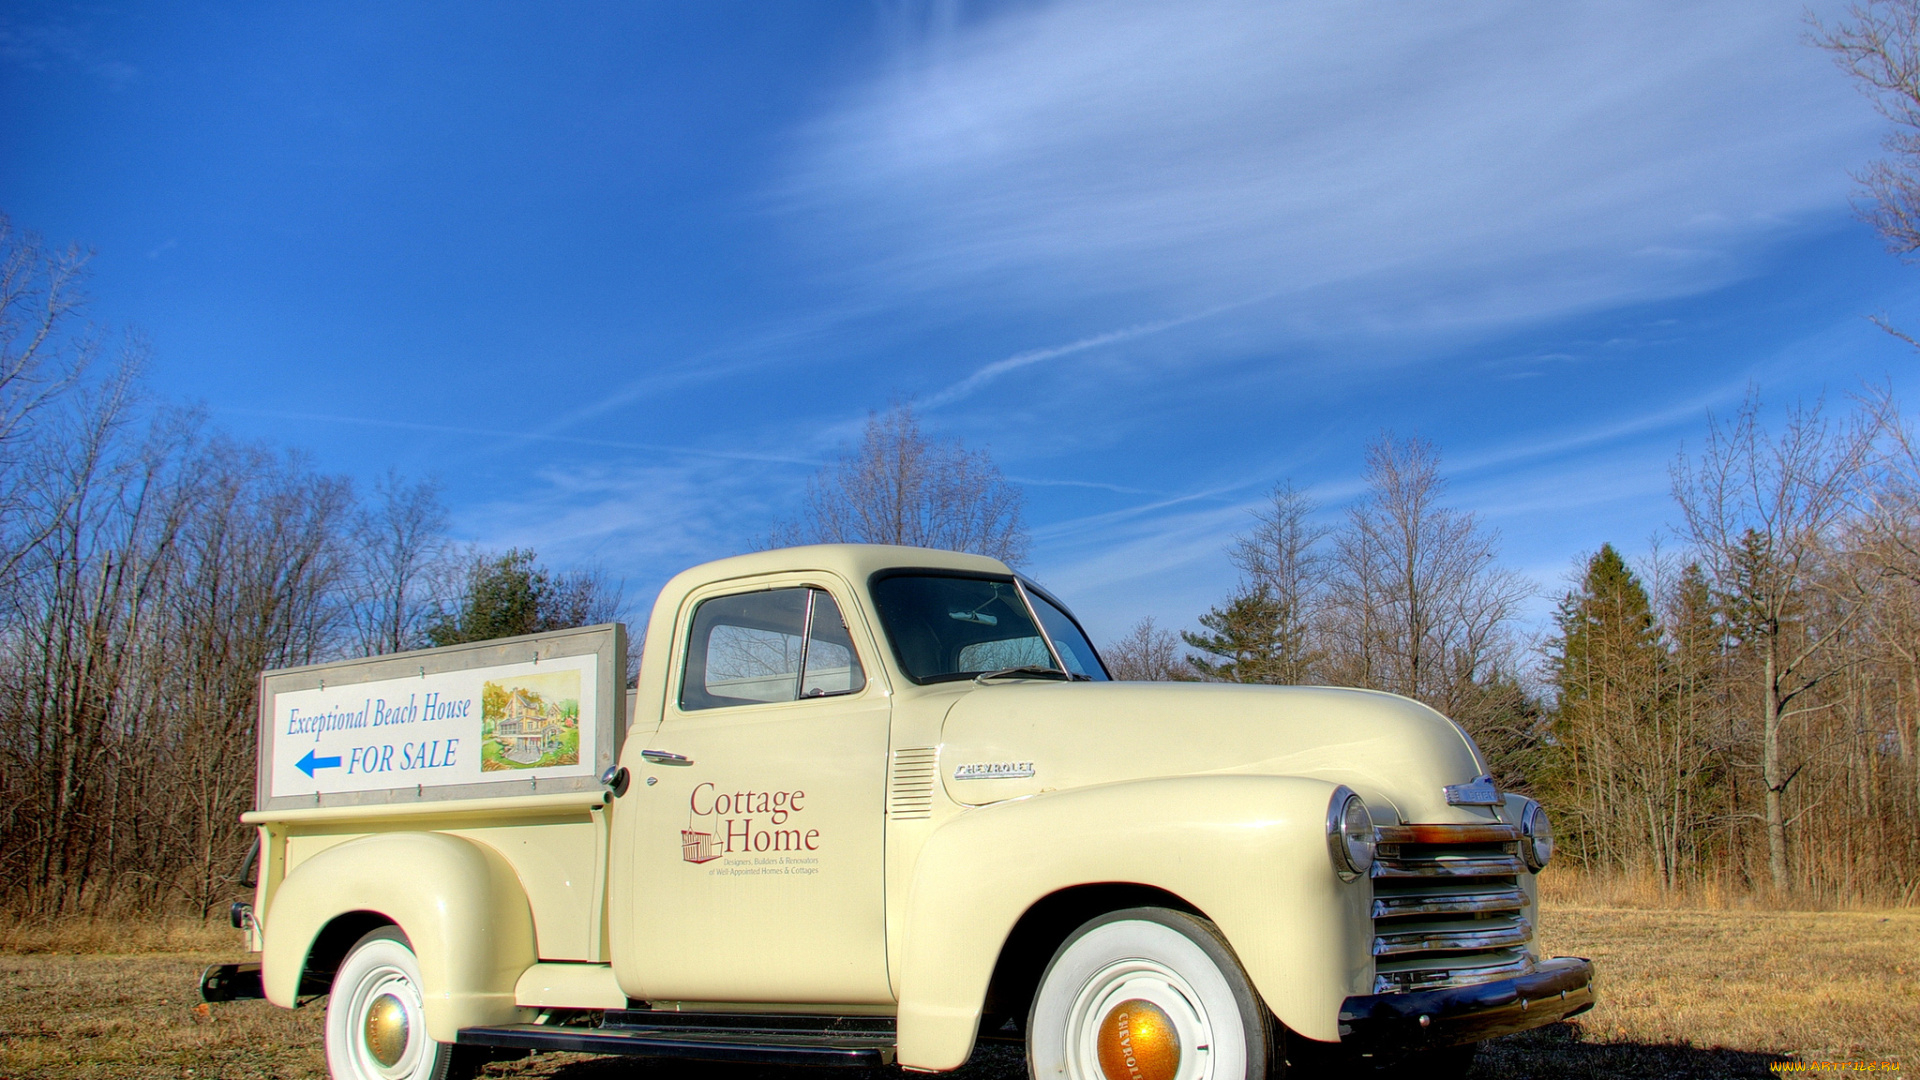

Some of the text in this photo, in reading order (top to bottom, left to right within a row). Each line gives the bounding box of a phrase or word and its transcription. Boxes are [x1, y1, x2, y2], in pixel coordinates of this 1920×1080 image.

[287, 692, 472, 742] Exceptional Beach House
[347, 738, 459, 775] FOR SALE
[955, 762, 1034, 775] CHEVROLET
[690, 782, 805, 825] Cottage
[724, 818, 820, 853] Home
[754, 857, 778, 866] Builders
[779, 857, 784, 865] &
[785, 857, 819, 865] Renovators
[761, 866, 783, 875] Homes
[784, 867, 789, 875] &
[790, 866, 819, 875] Cottages
